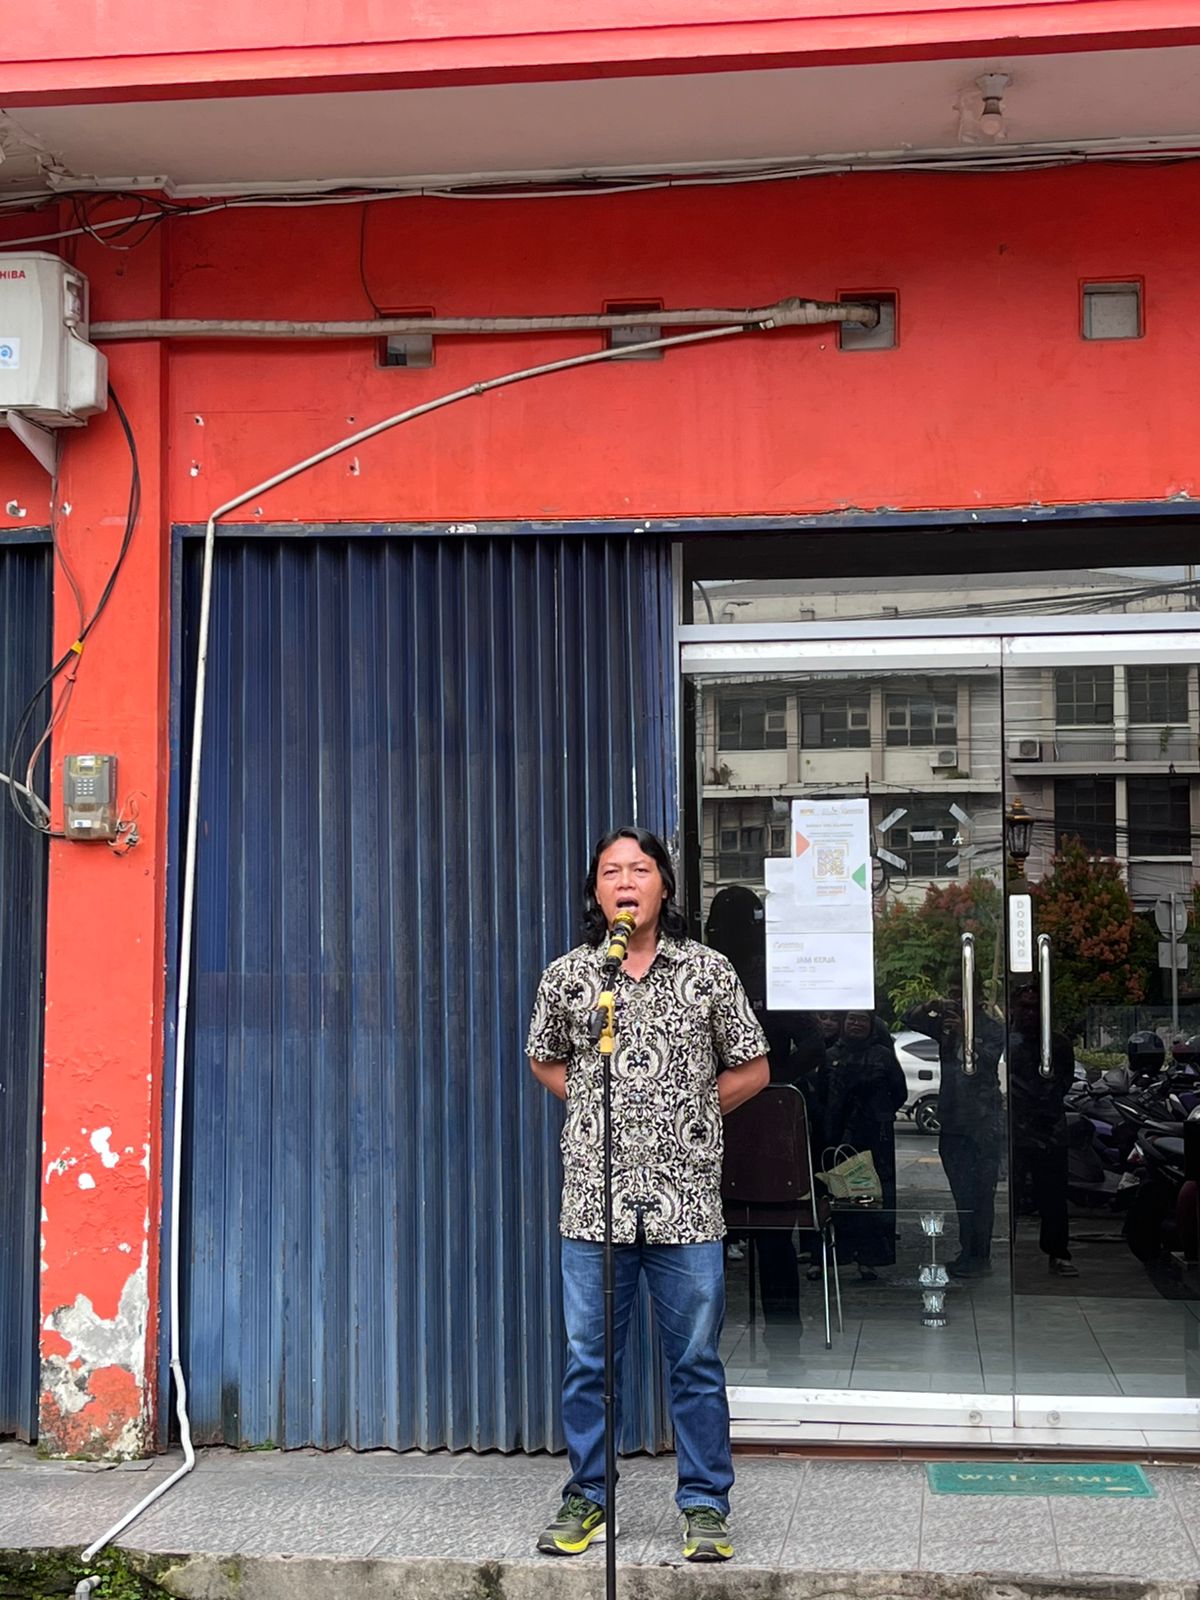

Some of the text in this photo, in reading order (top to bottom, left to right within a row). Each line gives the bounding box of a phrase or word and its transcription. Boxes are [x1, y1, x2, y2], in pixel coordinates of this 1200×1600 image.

[1016, 900, 1025, 957] DORONG
[796, 955, 836, 964] JAM KERJA
